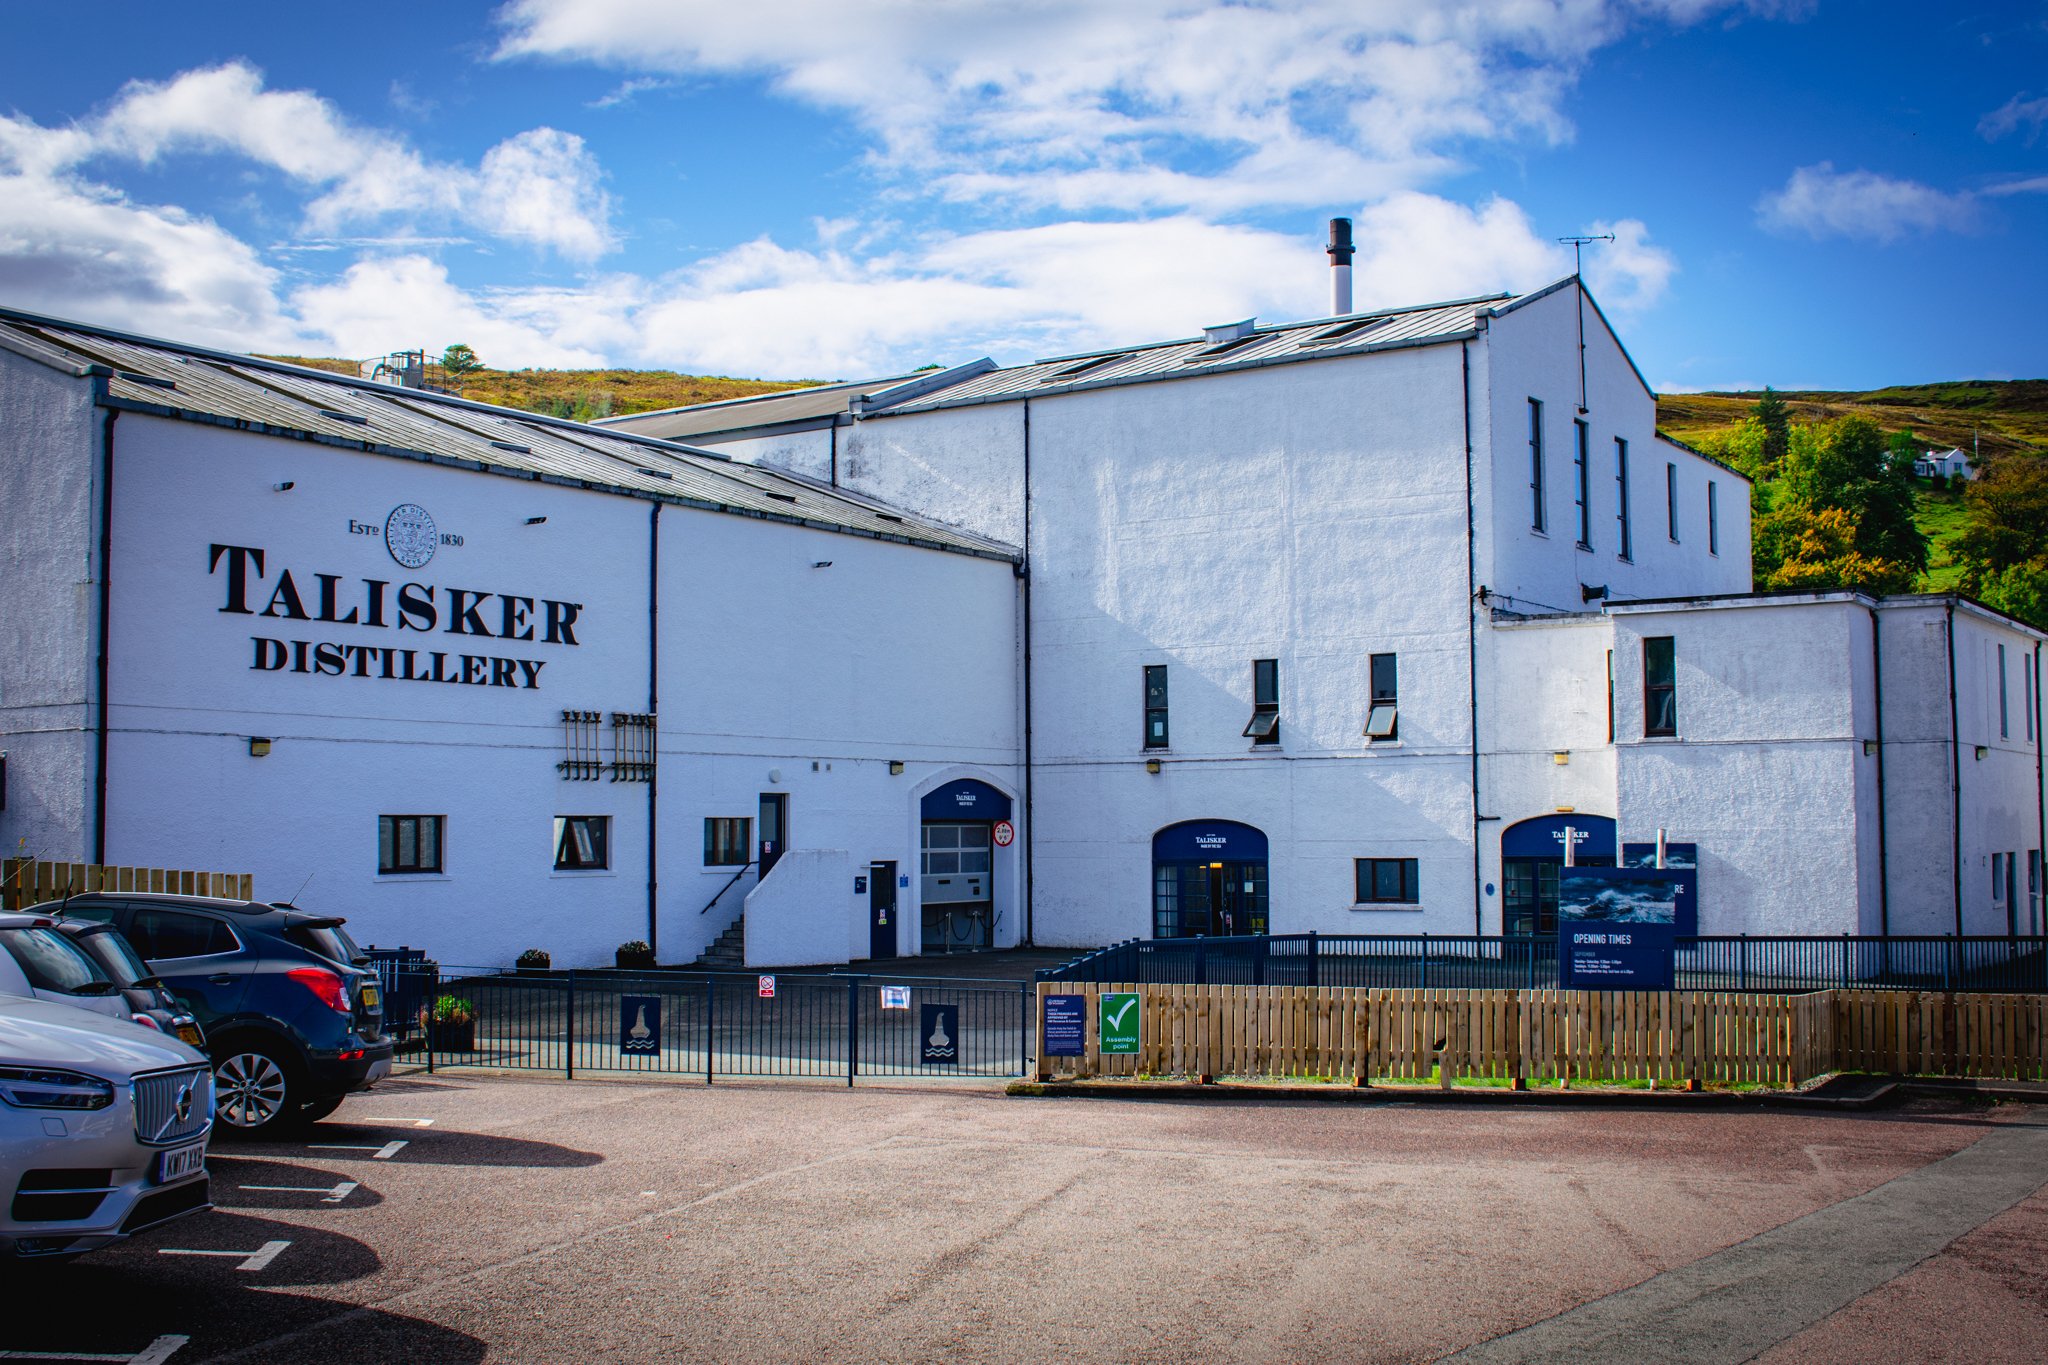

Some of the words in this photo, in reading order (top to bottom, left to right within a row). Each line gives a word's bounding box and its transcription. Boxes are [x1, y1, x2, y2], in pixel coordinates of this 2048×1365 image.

[440, 533, 464, 547] 1830
[401, 555, 421, 564] SKYE
[210, 543, 580, 645] TALISKER
[250, 637, 547, 689] DISTILLERY
[1195, 836, 1227, 844] TALISKER
[1674, 884, 1684, 894] RE
[1573, 933, 1606, 944] OPENING
[1608, 934, 1632, 945] TIMES
[1105, 1036, 1136, 1044] Assembly
[166, 1151, 187, 1176] KW17
